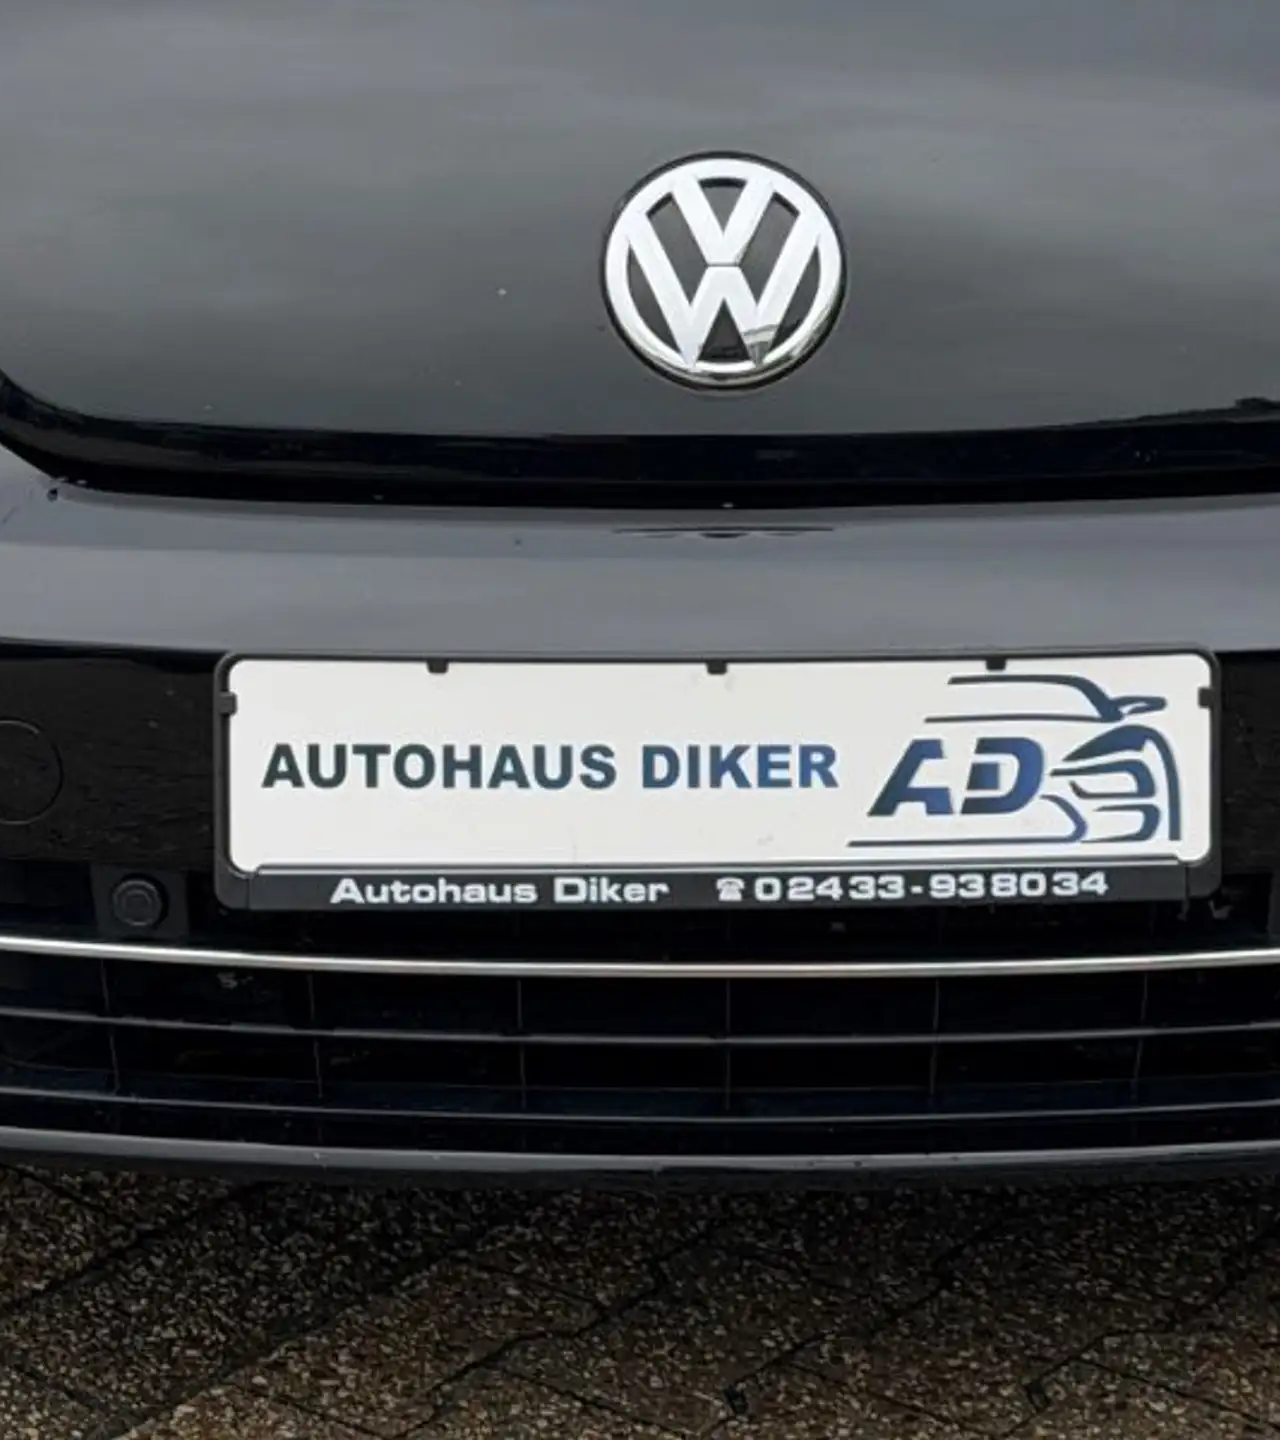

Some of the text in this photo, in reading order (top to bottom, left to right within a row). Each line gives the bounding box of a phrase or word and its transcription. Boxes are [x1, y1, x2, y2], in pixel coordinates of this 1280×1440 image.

[261, 743, 838, 789] AUTOHAUS DIKER
[867, 737, 1044, 817] AD
[329, 871, 1109, 905] Autohaus Diker 02433-938034
